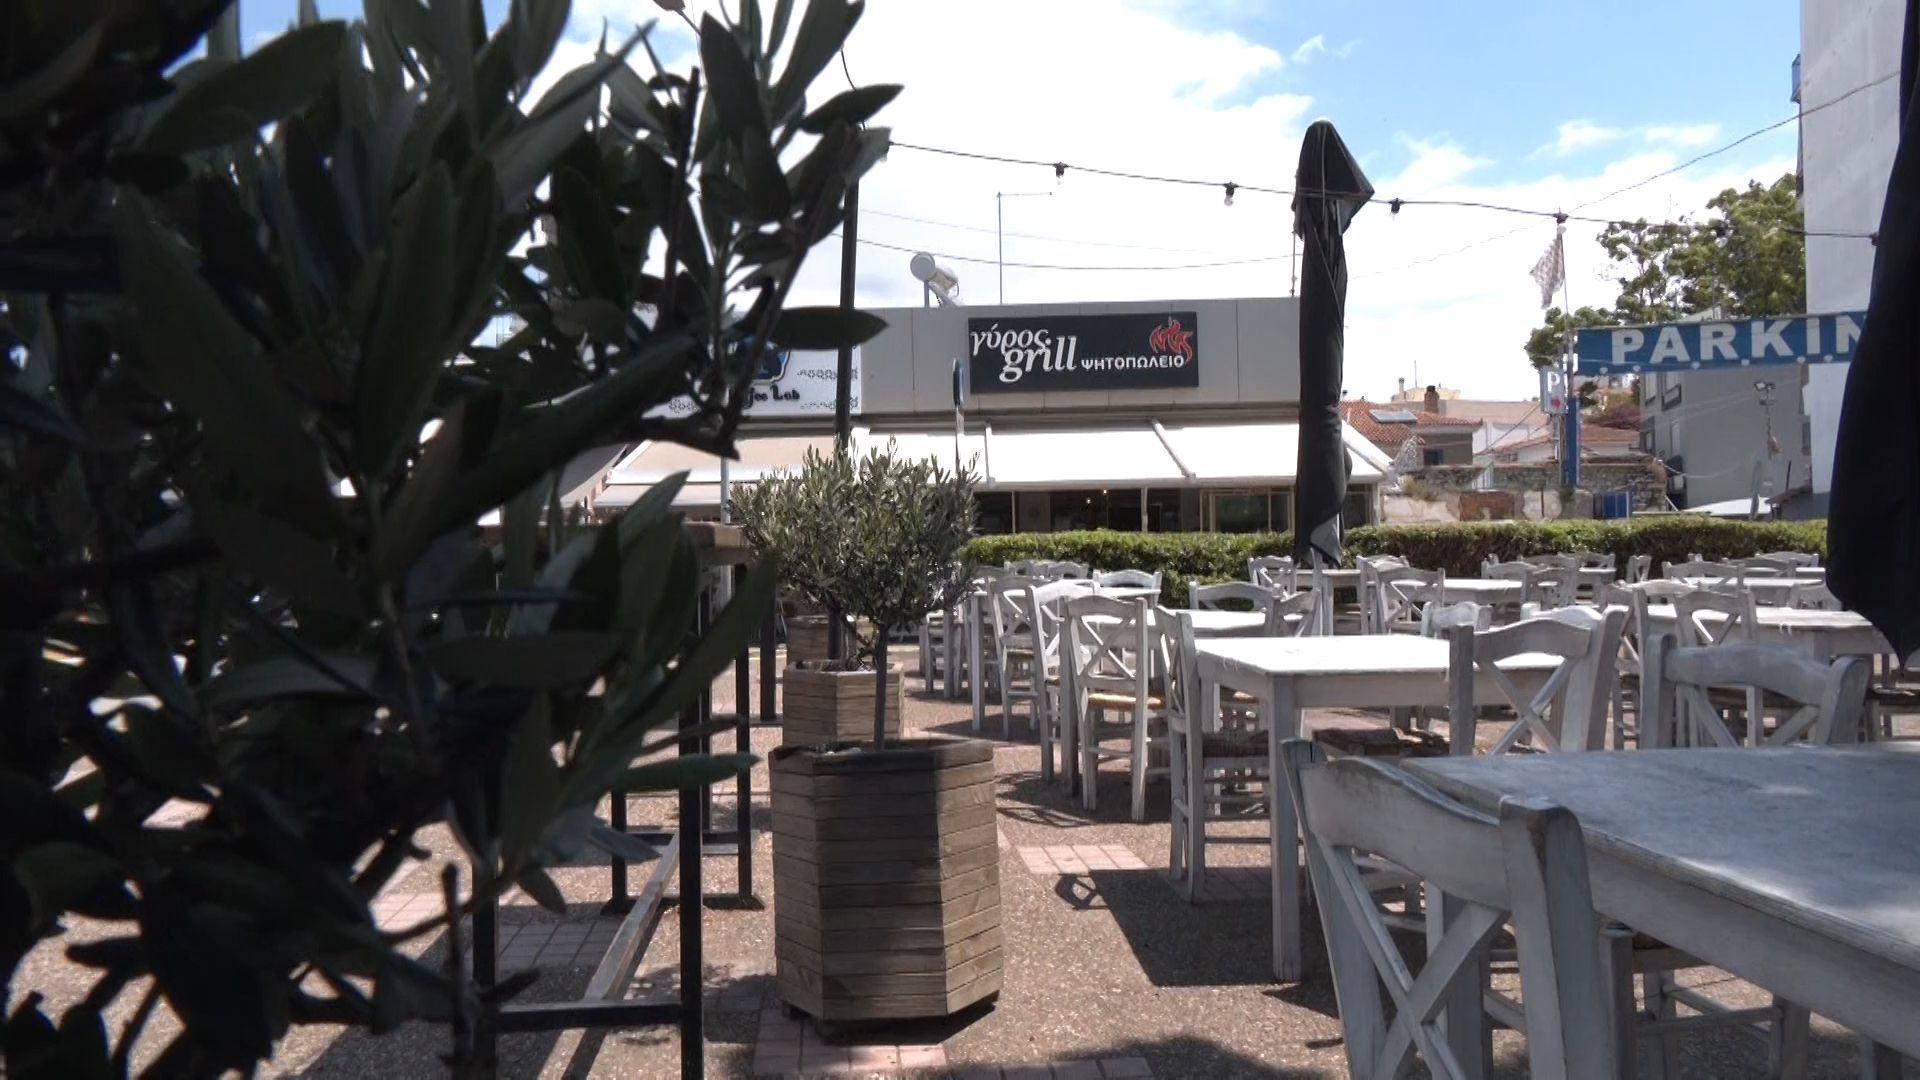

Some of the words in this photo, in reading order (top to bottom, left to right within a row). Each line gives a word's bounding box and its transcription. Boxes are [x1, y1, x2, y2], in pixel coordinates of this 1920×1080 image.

[970, 323, 1049, 356] γύρος
[999, 335, 1077, 383] grill
[1081, 355, 1184, 371] ΨΗΤΟΠΩΛΕΙΟ
[1547, 371, 1561, 392] P
[770, 384, 800, 401] Lab
